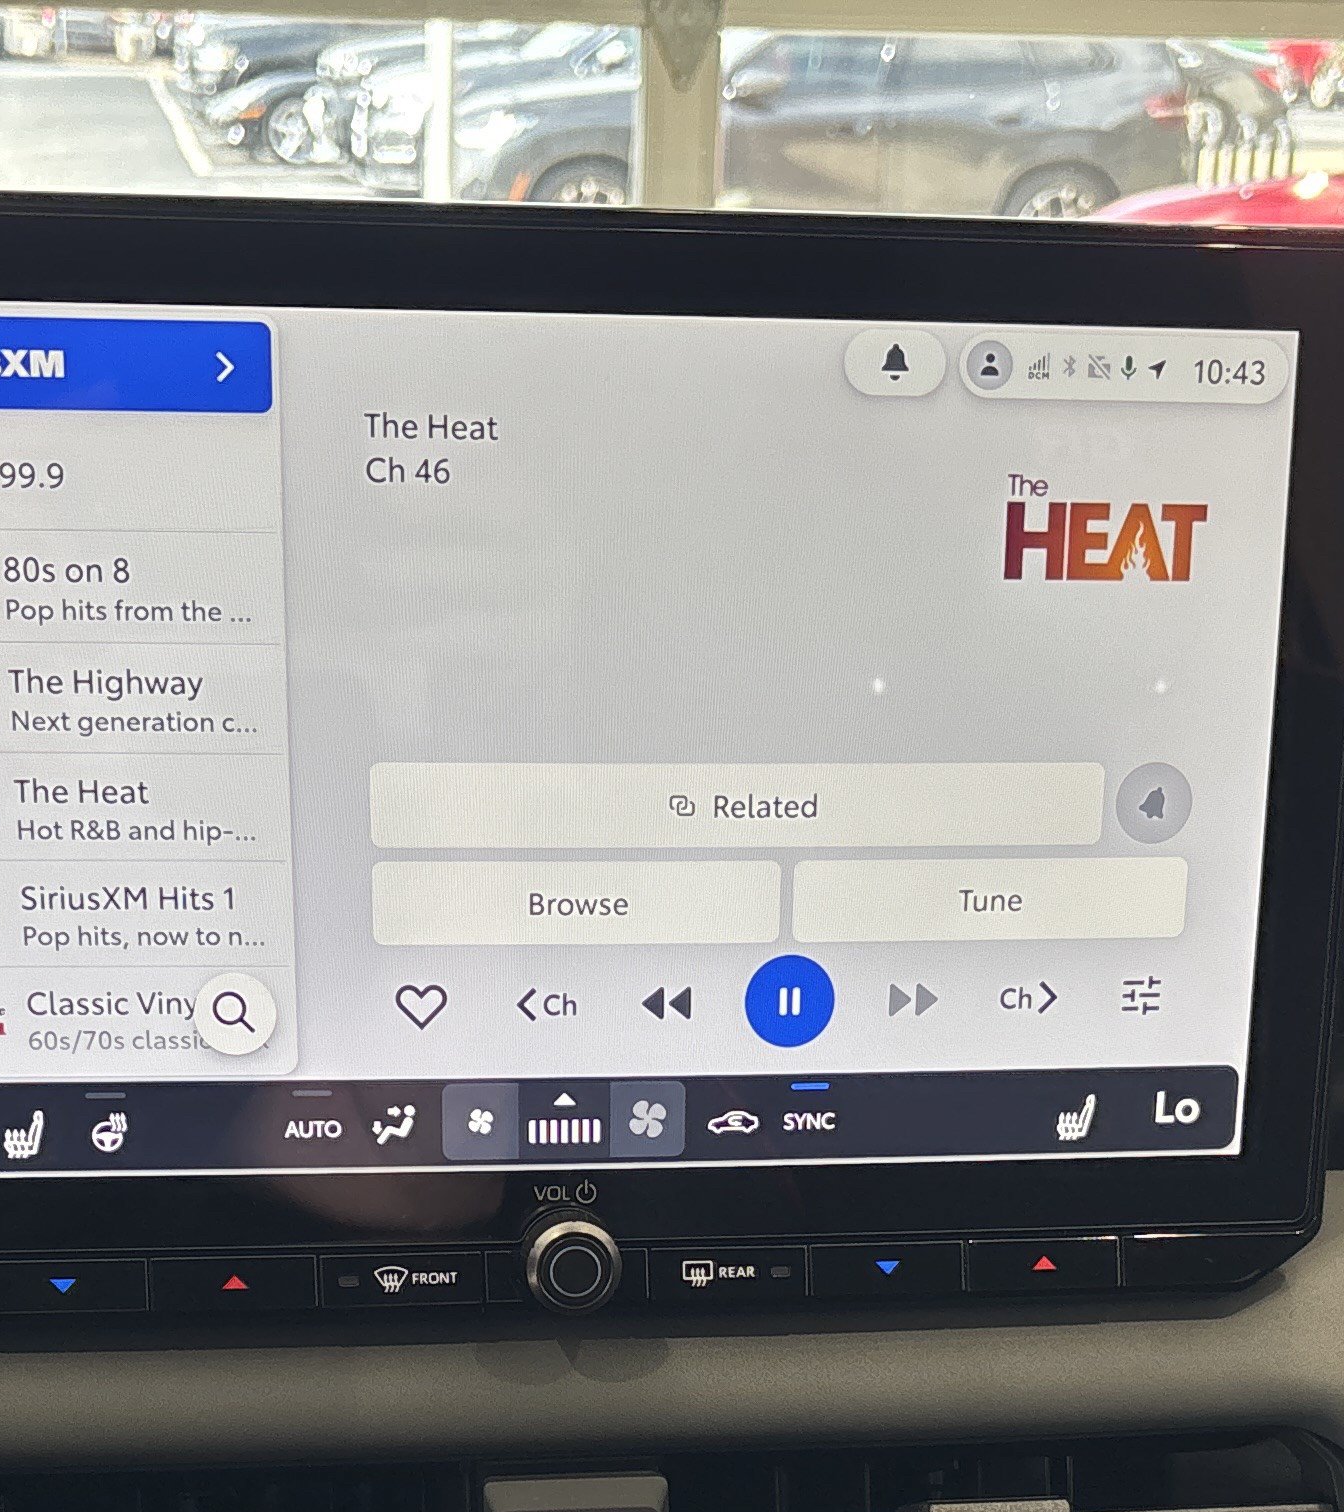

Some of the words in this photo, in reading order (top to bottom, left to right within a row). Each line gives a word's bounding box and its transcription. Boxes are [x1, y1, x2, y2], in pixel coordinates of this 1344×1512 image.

[1193, 359, 1266, 386] 10:43
[365, 413, 418, 439] The
[428, 414, 499, 441] Heat
[366, 457, 405, 483] Ch
[414, 458, 451, 484] 46
[1008, 474, 1048, 496] The
[1004, 502, 1208, 581] HEAT
[3, 557, 55, 583] 80s
[65, 563, 103, 583] on
[113, 559, 130, 583] 8
[6, 600, 54, 626] Pop
[61, 599, 107, 622] hits
[114, 600, 174, 622] from
[181, 601, 222, 622] the
[8, 669, 63, 694] The
[74, 669, 203, 700] Highway
[12, 711, 71, 733] Next
[78, 711, 214, 737] generation
[14, 780, 69, 805] The
[78, 781, 150, 805] Heat
[713, 794, 818, 819] Related
[17, 820, 63, 841] Hot
[71, 820, 121, 841] R&B
[129, 821, 175, 842] and
[21, 887, 148, 911] SiriusXM
[159, 887, 214, 911] Hits
[223, 887, 235, 910] 1
[529, 893, 628, 916] Browse
[959, 890, 1022, 913] Tune
[23, 926, 70, 951] Pop
[78, 926, 130, 951] hits,
[138, 930, 189, 946] now
[196, 928, 222, 946] to
[27, 992, 129, 1016] Classic
[137, 992, 197, 1020] Viny
[543, 993, 576, 1017] Ch
[1000, 987, 1032, 1010] Ch
[28, 1030, 125, 1054] 60s/70s
[1155, 1091, 1200, 1125] Lo
[285, 1120, 342, 1139] AUTO
[782, 1112, 836, 1132] SYNC
[534, 1186, 570, 1201] VOL
[412, 1270, 457, 1286] FRONT
[719, 1265, 755, 1279] REAR
